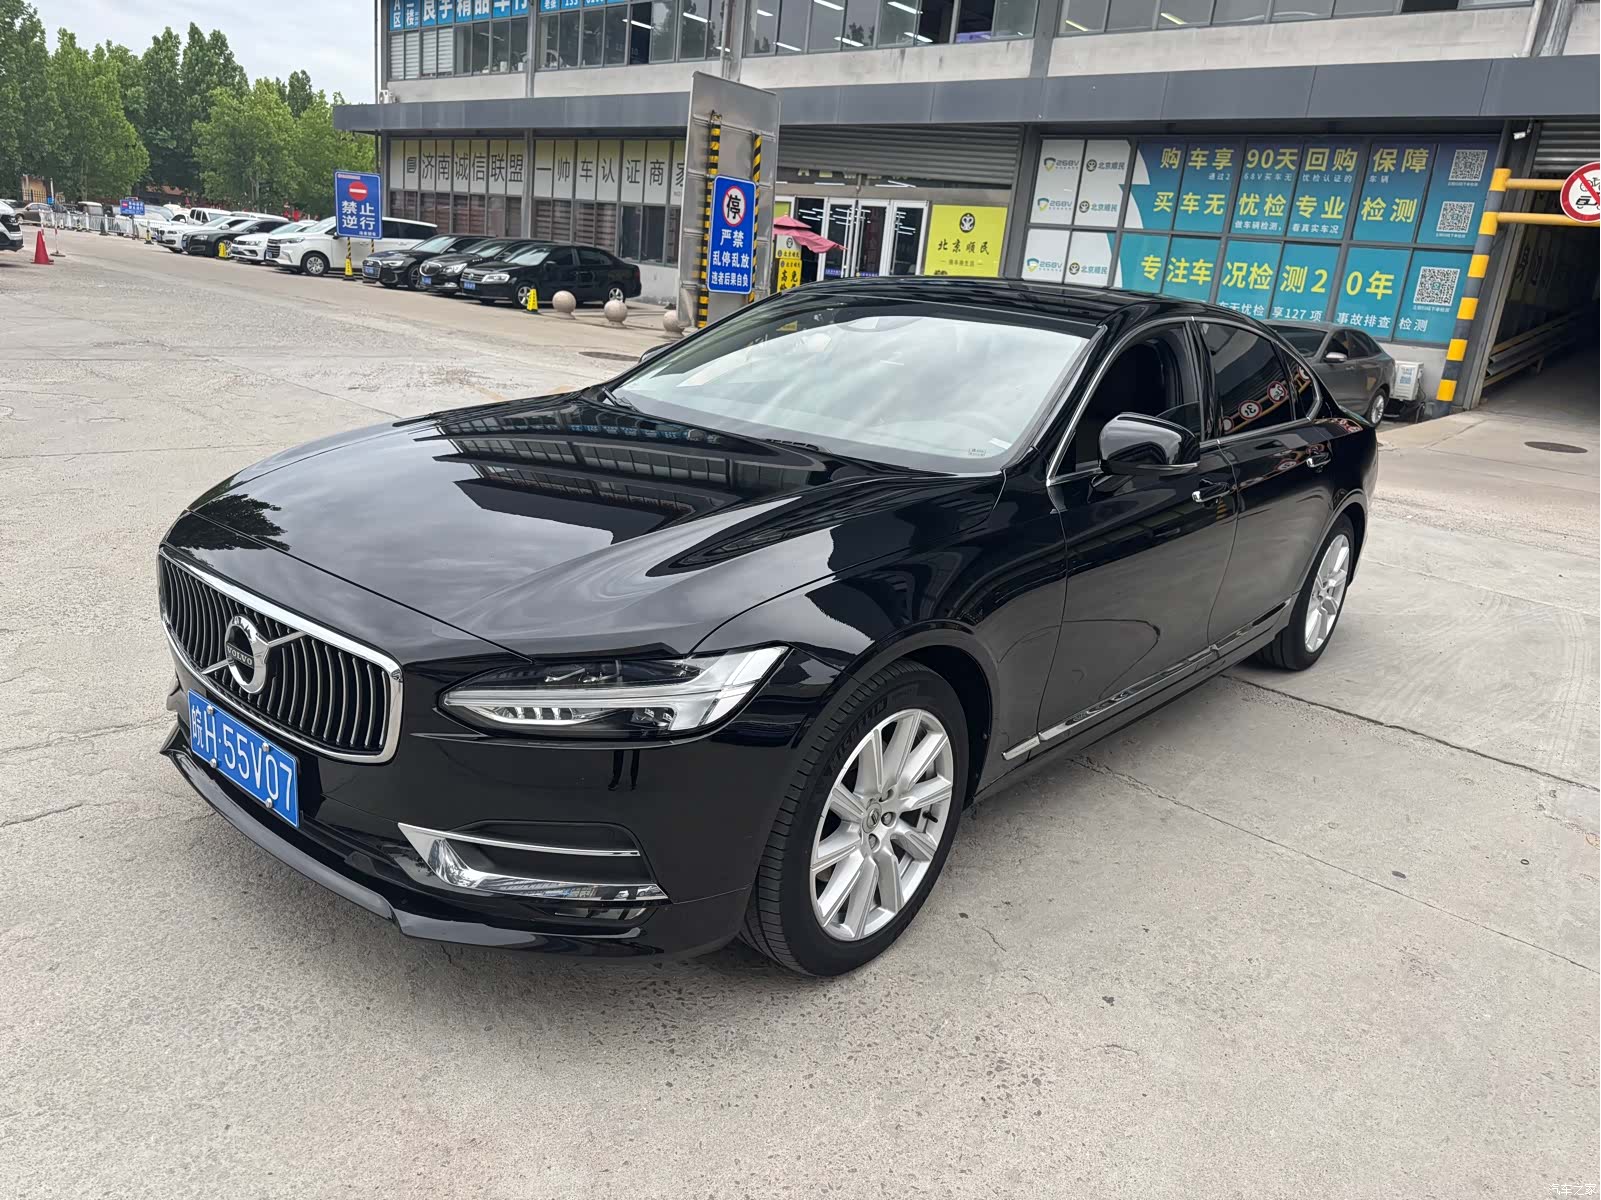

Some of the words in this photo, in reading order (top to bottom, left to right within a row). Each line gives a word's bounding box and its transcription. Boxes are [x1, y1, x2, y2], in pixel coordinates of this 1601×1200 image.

[421, 152, 523, 183] 济南诚信联盟
[342, 200, 376, 216] 禁止
[726, 194, 742, 219] 停
[342, 215, 376, 231] 逆行
[720, 228, 745, 249] 严禁
[938, 238, 990, 256] 北京顺民
[712, 250, 750, 269] 乱停乱放
[226, 645, 253, 666] VOLVO
